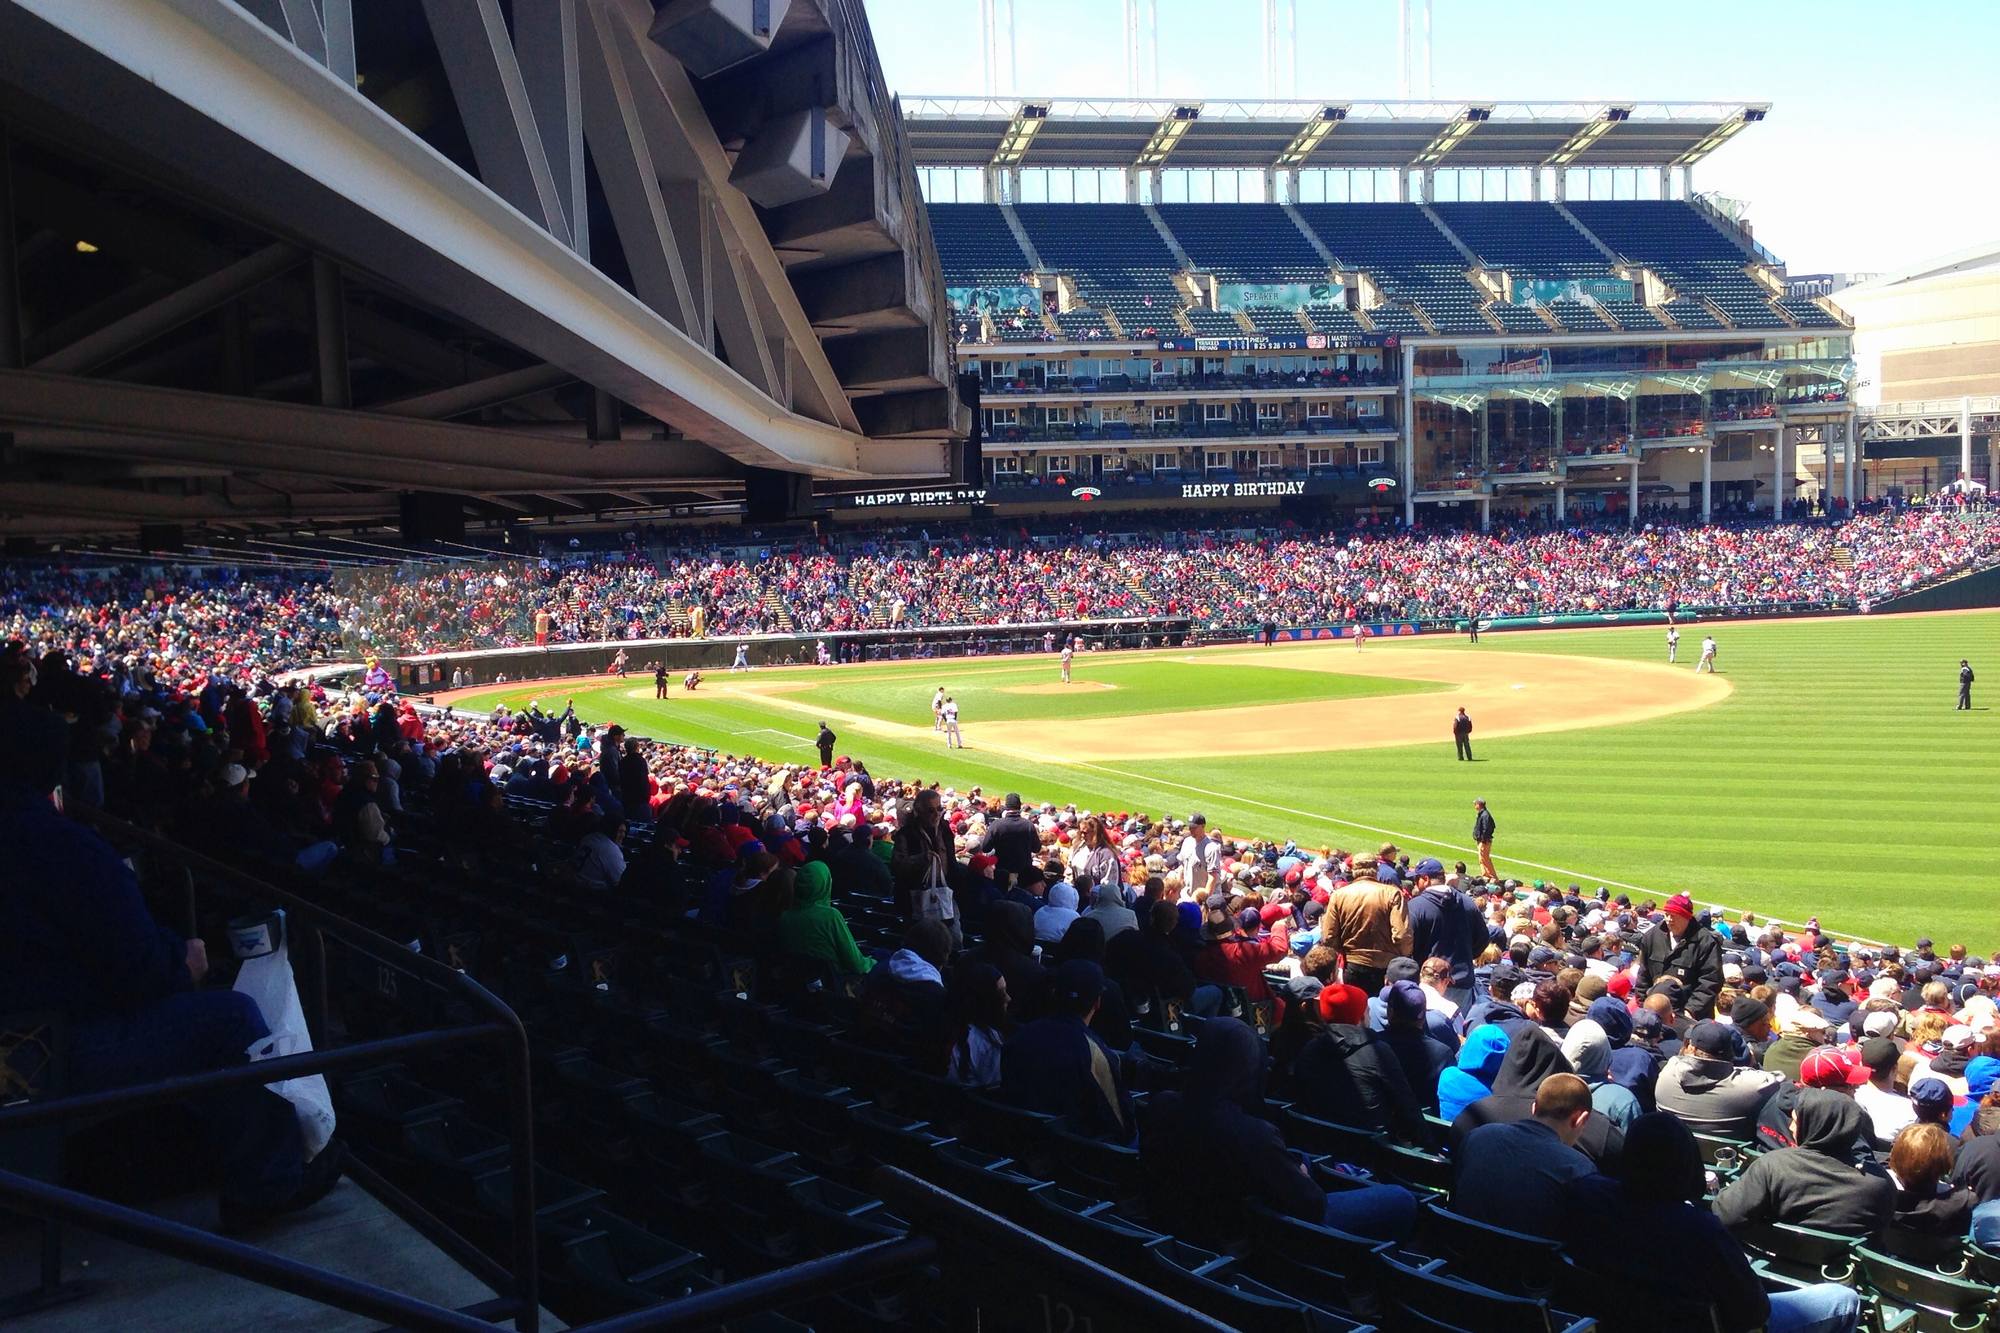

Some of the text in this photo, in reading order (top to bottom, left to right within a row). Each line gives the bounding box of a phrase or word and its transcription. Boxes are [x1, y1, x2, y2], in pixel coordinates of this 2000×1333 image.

[1243, 291, 1279, 301] SPEAKER
[1163, 341, 1175, 349] 4th
[1182, 481, 1305, 498] HAPPY BIRTHDAY
[855, 493, 905, 505] HAPPY
